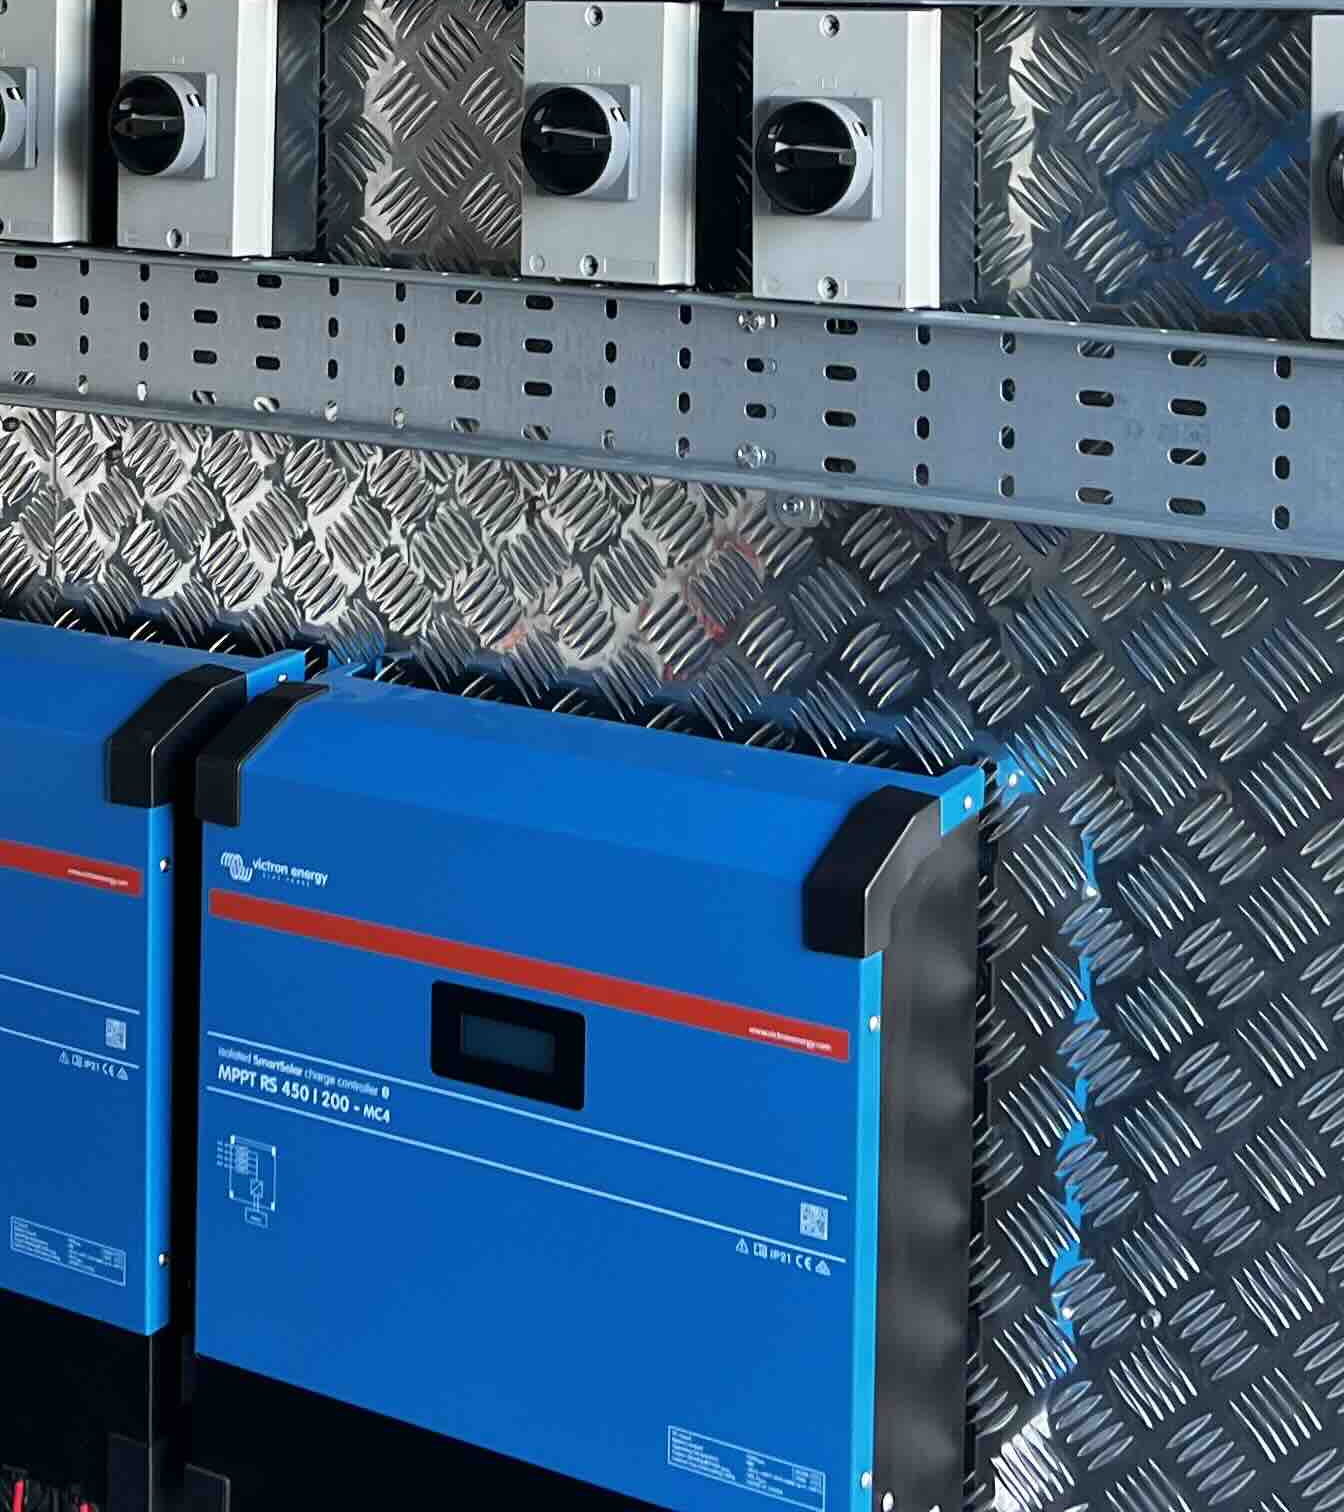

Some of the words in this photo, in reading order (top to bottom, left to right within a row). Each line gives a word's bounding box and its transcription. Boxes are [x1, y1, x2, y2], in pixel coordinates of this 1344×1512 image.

[253, 857, 289, 875] victron
[291, 867, 328, 888] energy
[253, 1054, 303, 1076] SmartSolar
[218, 1064, 256, 1087] MPPT
[260, 1074, 278, 1093] RS
[281, 1080, 309, 1102] 450
[321, 1090, 350, 1113] 200
[363, 1103, 390, 1124] MC4
